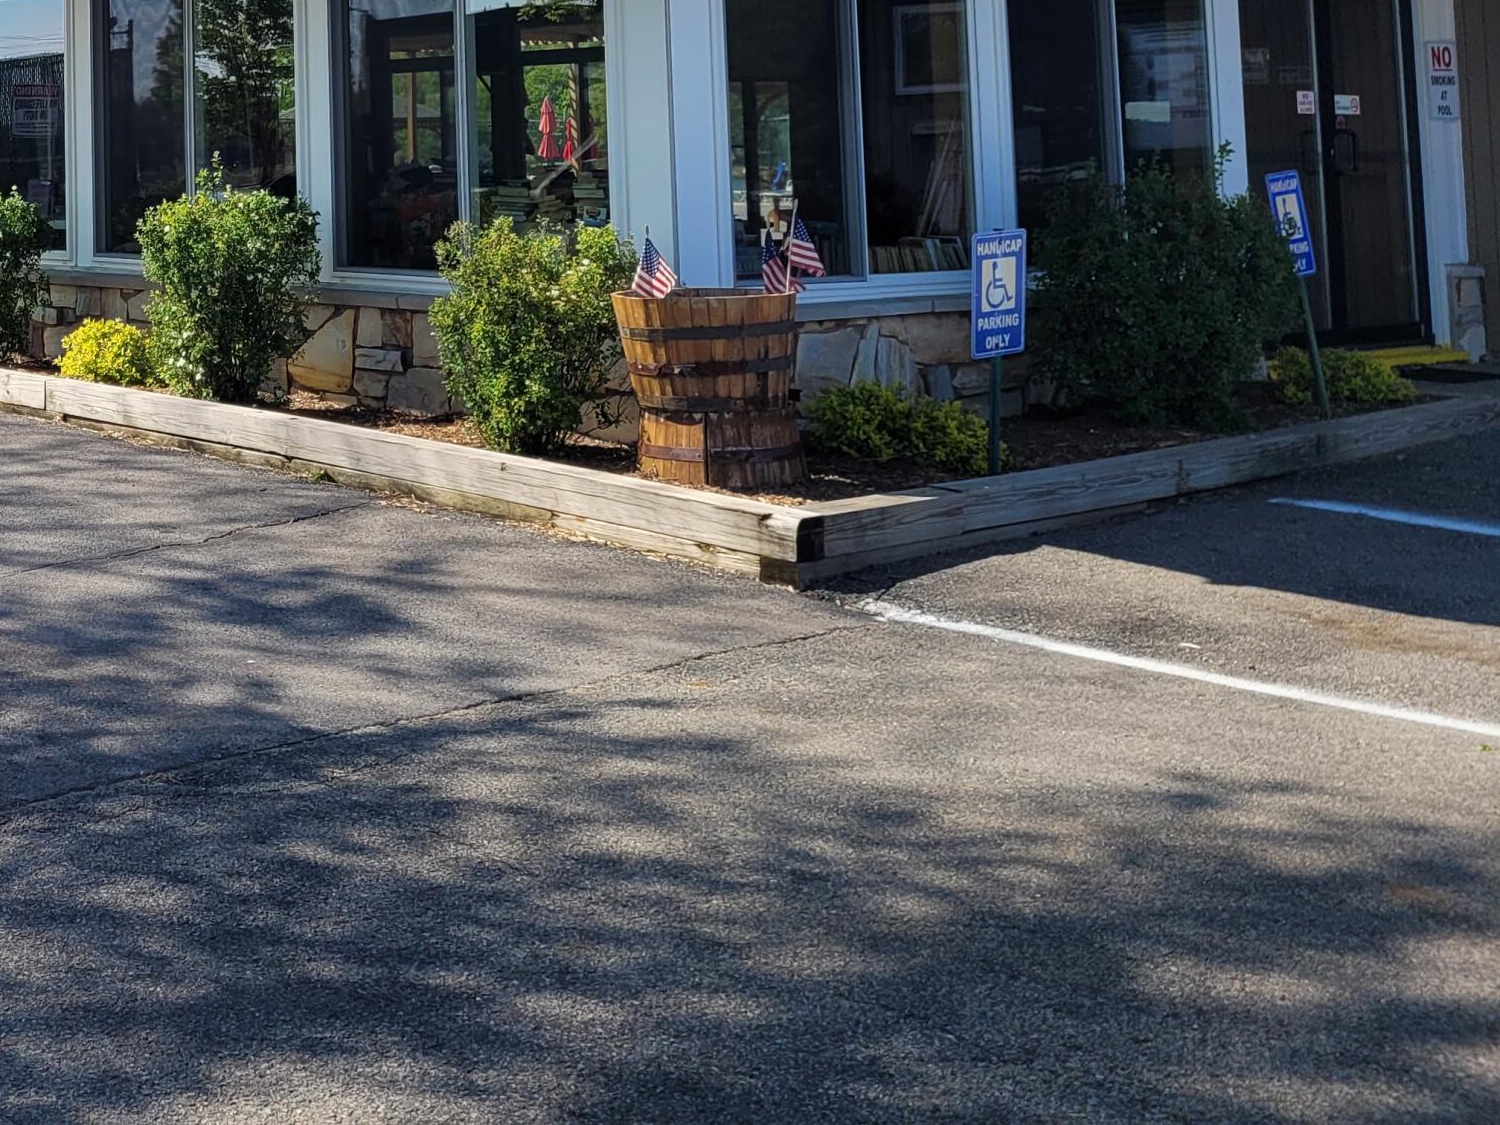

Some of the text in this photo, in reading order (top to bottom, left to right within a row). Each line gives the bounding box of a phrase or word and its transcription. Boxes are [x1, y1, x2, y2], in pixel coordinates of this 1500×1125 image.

[1431, 46, 1452, 68] NO
[1430, 75, 1456, 86] SMOKING
[1441, 90, 1447, 101] AT
[1438, 104, 1452, 116] POOL
[978, 313, 1019, 331] PARKING
[985, 333, 1010, 350] ONLY
